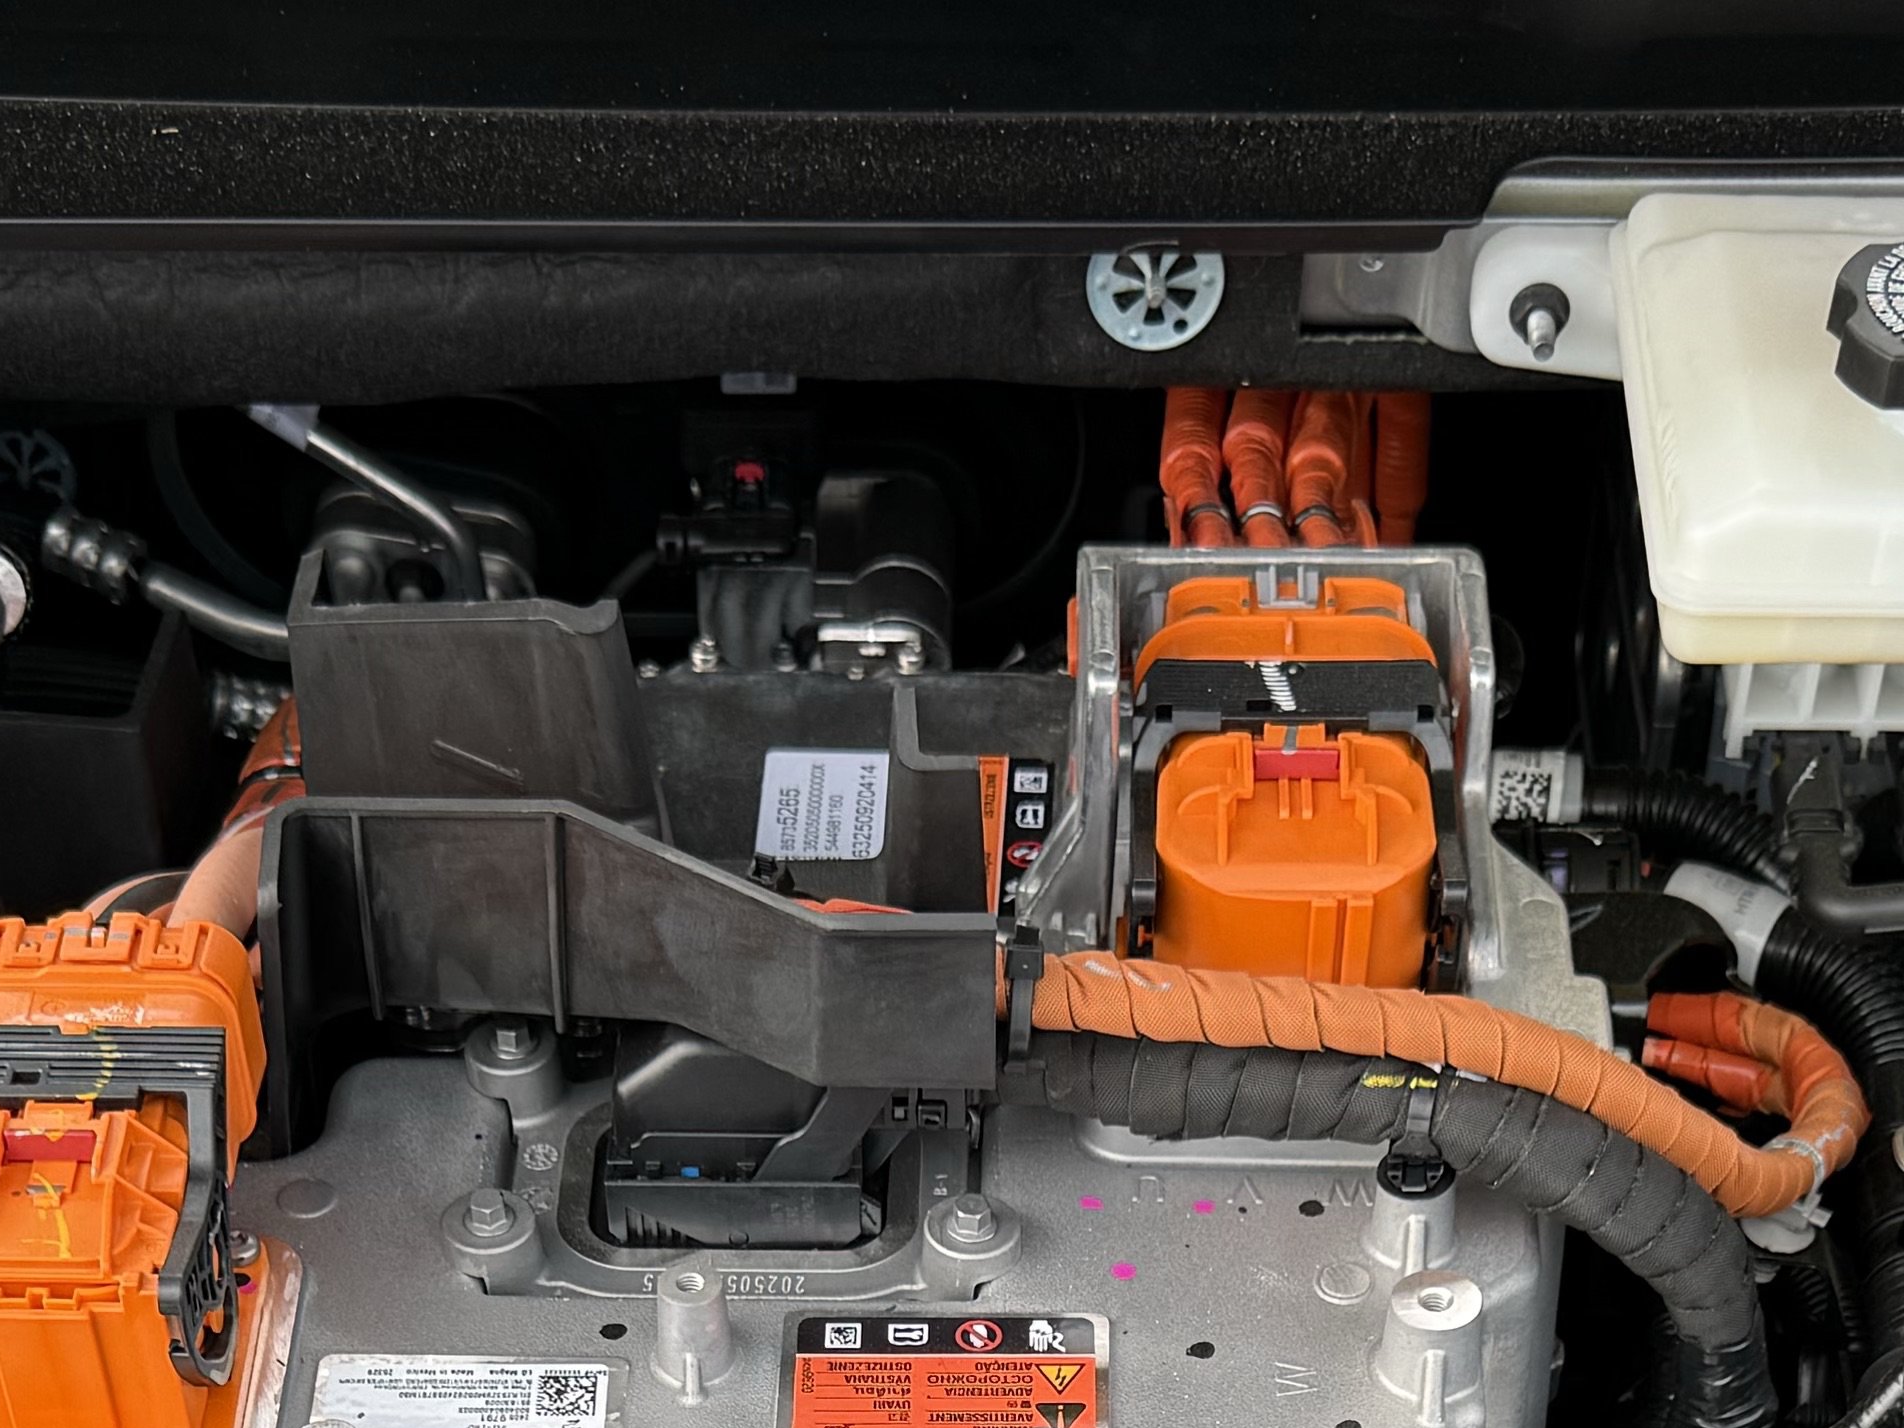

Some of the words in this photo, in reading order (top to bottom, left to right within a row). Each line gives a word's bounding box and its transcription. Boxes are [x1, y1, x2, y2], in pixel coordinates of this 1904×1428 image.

[405, 1368, 436, 1376] Mexico
[450, 1368, 474, 1376] Made
[488, 1366, 518, 1376] Magna
[926, 1371, 1033, 1387] ОСТОРОЖНО
[943, 1384, 1032, 1399] ADVERTENCIA
[872, 1398, 911, 1410] UYARI
[927, 1409, 1033, 1426] AVERTISSEMENT
